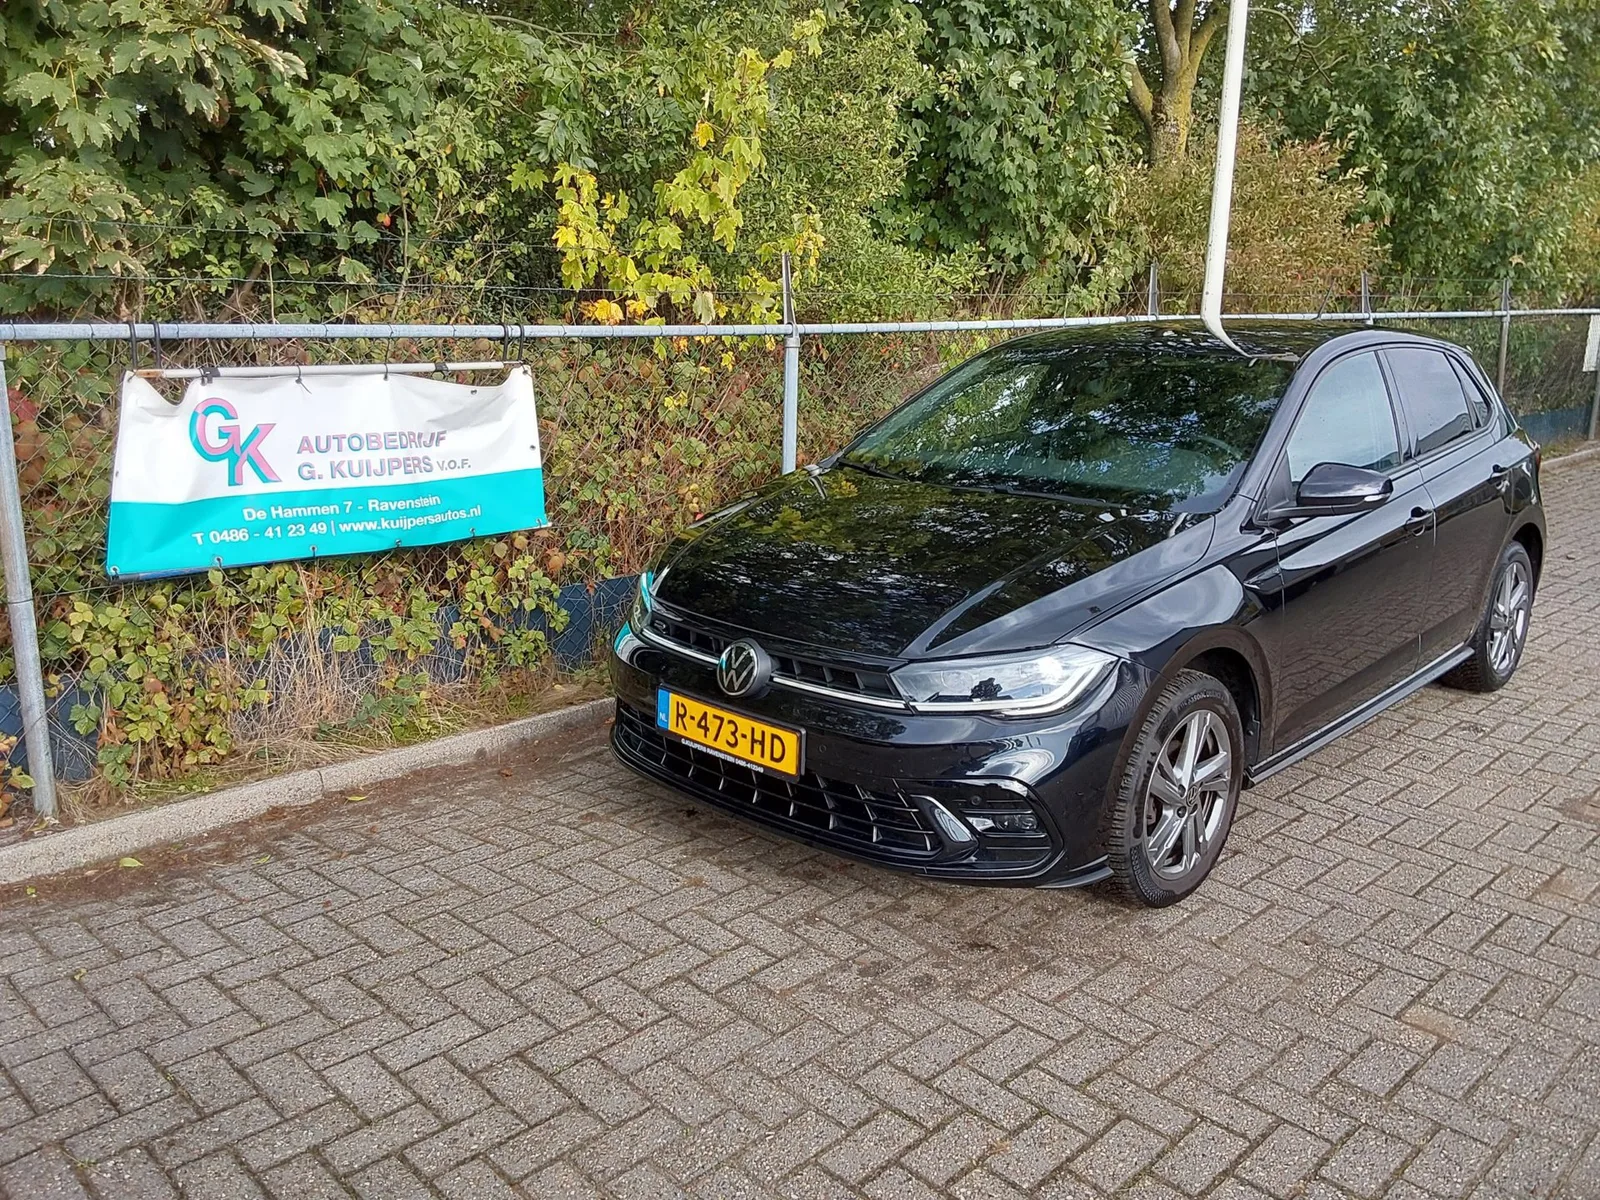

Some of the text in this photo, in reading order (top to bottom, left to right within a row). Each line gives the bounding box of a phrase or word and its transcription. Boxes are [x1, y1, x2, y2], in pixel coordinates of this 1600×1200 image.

[189, 397, 282, 486] GK
[296, 430, 447, 454] AUTOBEDRIJF
[297, 455, 472, 481] G. KUIJPERS V.O.F.
[242, 507, 267, 521] De
[270, 503, 340, 519] Hammen
[343, 501, 353, 514] 7
[367, 494, 441, 512] Ravenstein
[191, 531, 205, 546] T
[208, 528, 250, 544] 0486
[264, 526, 283, 539] 41
[287, 523, 306, 538] 23
[309, 521, 328, 536] 49
[339, 505, 481, 531] www.kuijpersautos.nl
[659, 711, 668, 723] NL
[675, 700, 786, 764] R-473-HD
